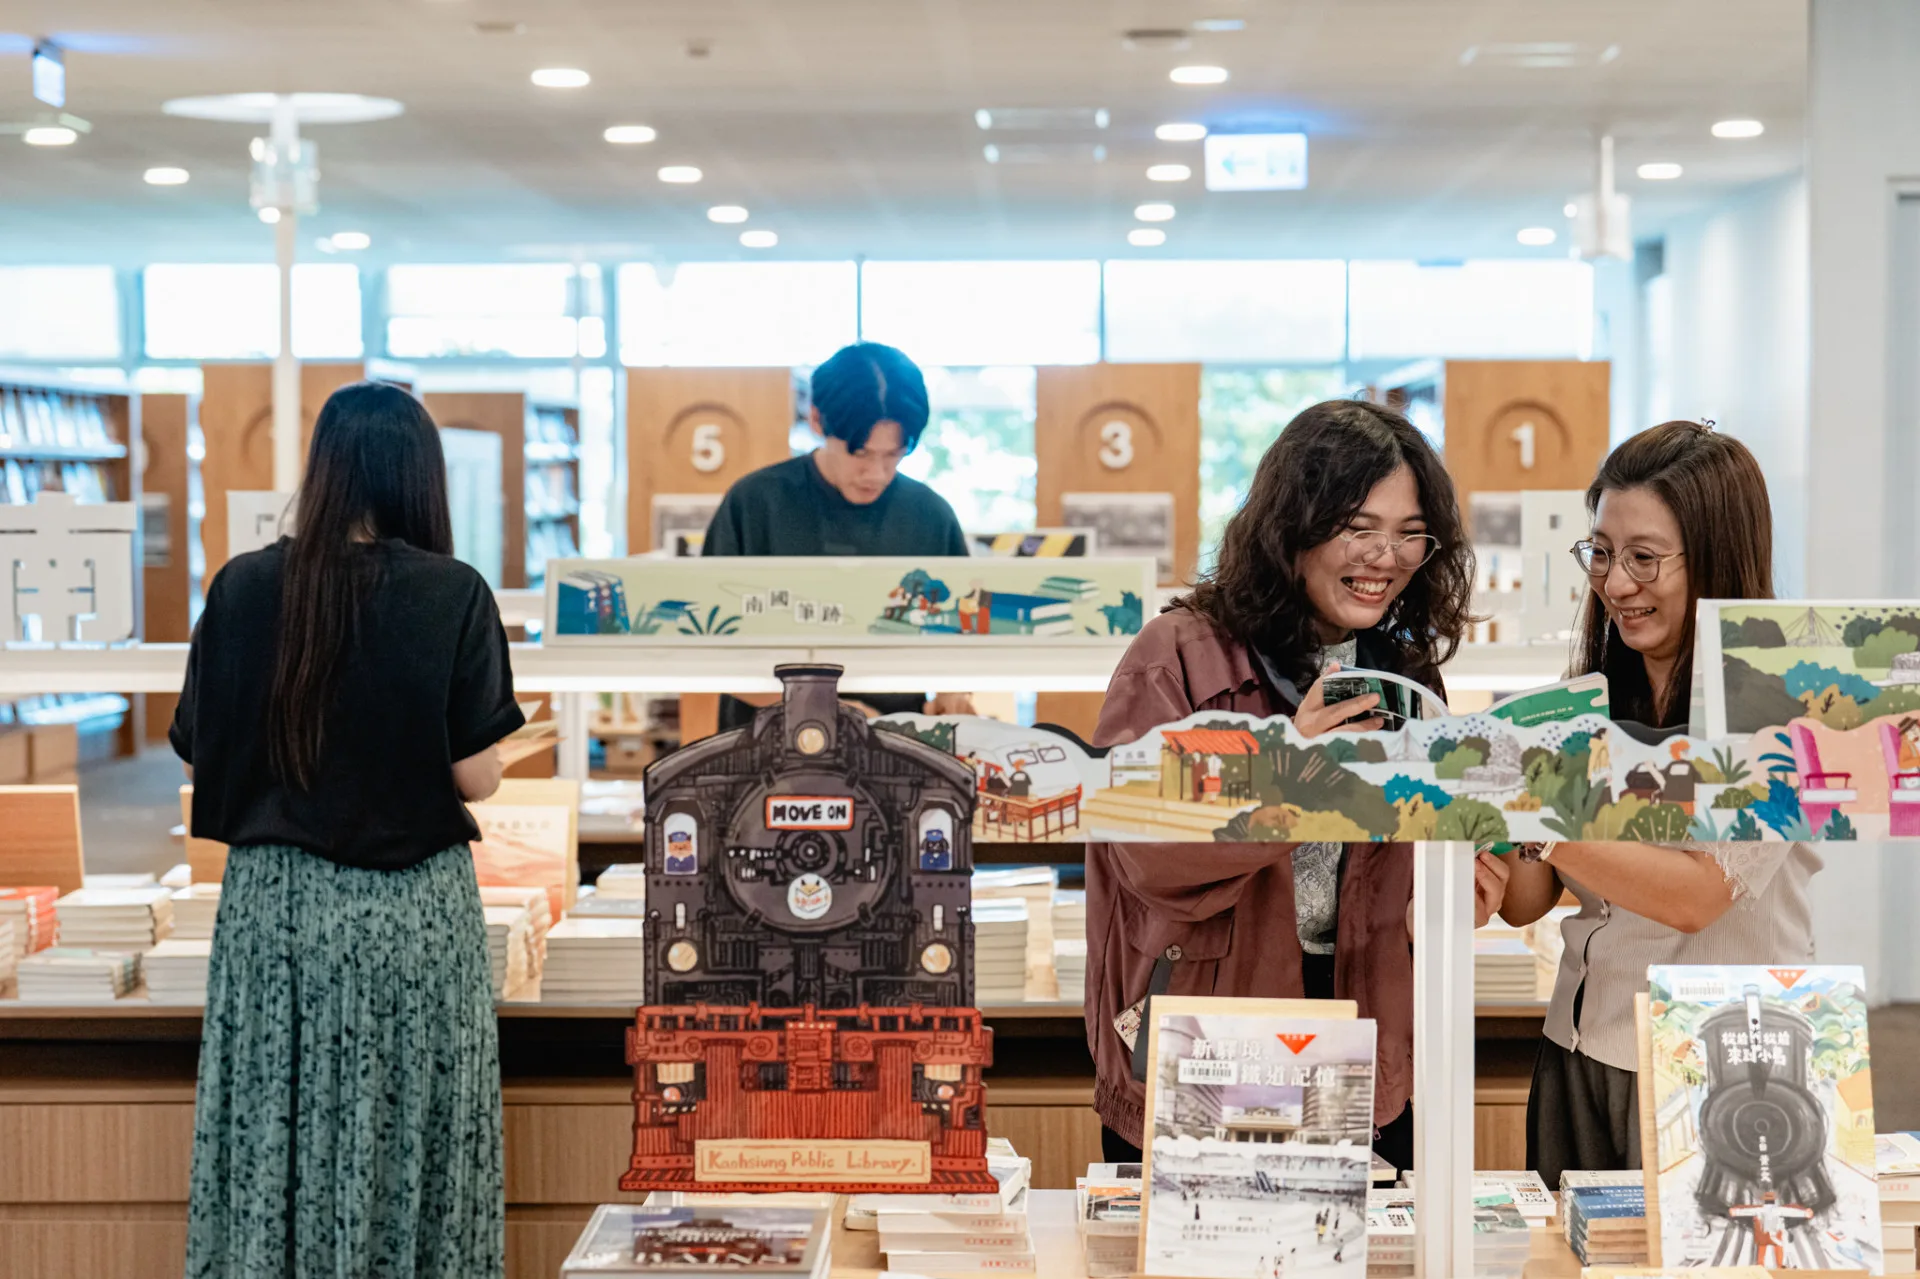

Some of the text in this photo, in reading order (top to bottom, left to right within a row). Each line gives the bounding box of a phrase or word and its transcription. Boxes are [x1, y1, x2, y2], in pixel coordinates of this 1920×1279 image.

[691, 424, 725, 472] 5
[1099, 421, 1134, 469] 3
[1512, 422, 1535, 469] 1
[772, 804, 847, 822] MOVE ON
[791, 1151, 835, 1169] Public
